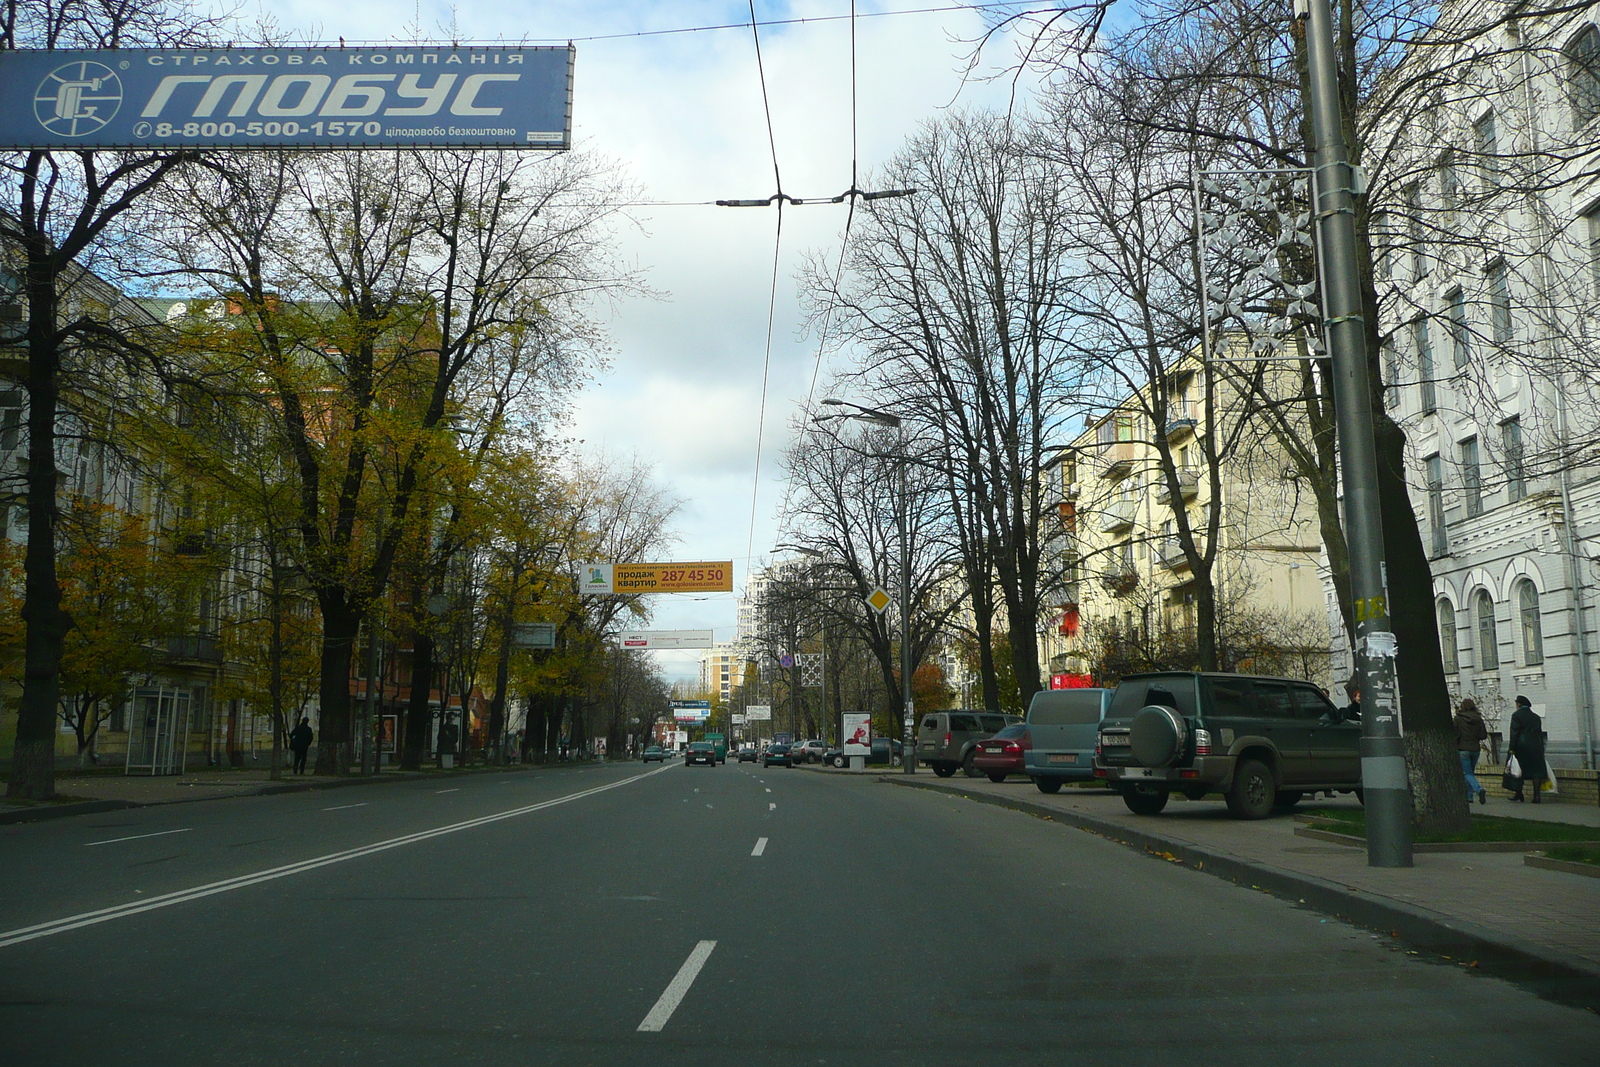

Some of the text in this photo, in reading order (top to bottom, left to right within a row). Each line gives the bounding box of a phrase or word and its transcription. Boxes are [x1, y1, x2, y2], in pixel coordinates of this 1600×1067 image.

[147, 53, 525, 66] СТРАХОВА КОМПАНІЯ
[140, 73, 522, 117] ГЛОБУС
[155, 121, 382, 137] 8-800-500-1570
[385, 125, 447, 138] цілодовобо
[448, 125, 517, 137] безкоштовно
[617, 570, 655, 579] продаж
[661, 569, 724, 582] 287 45 50
[617, 579, 657, 588] квартир
[1355, 596, 1385, 622] 18
